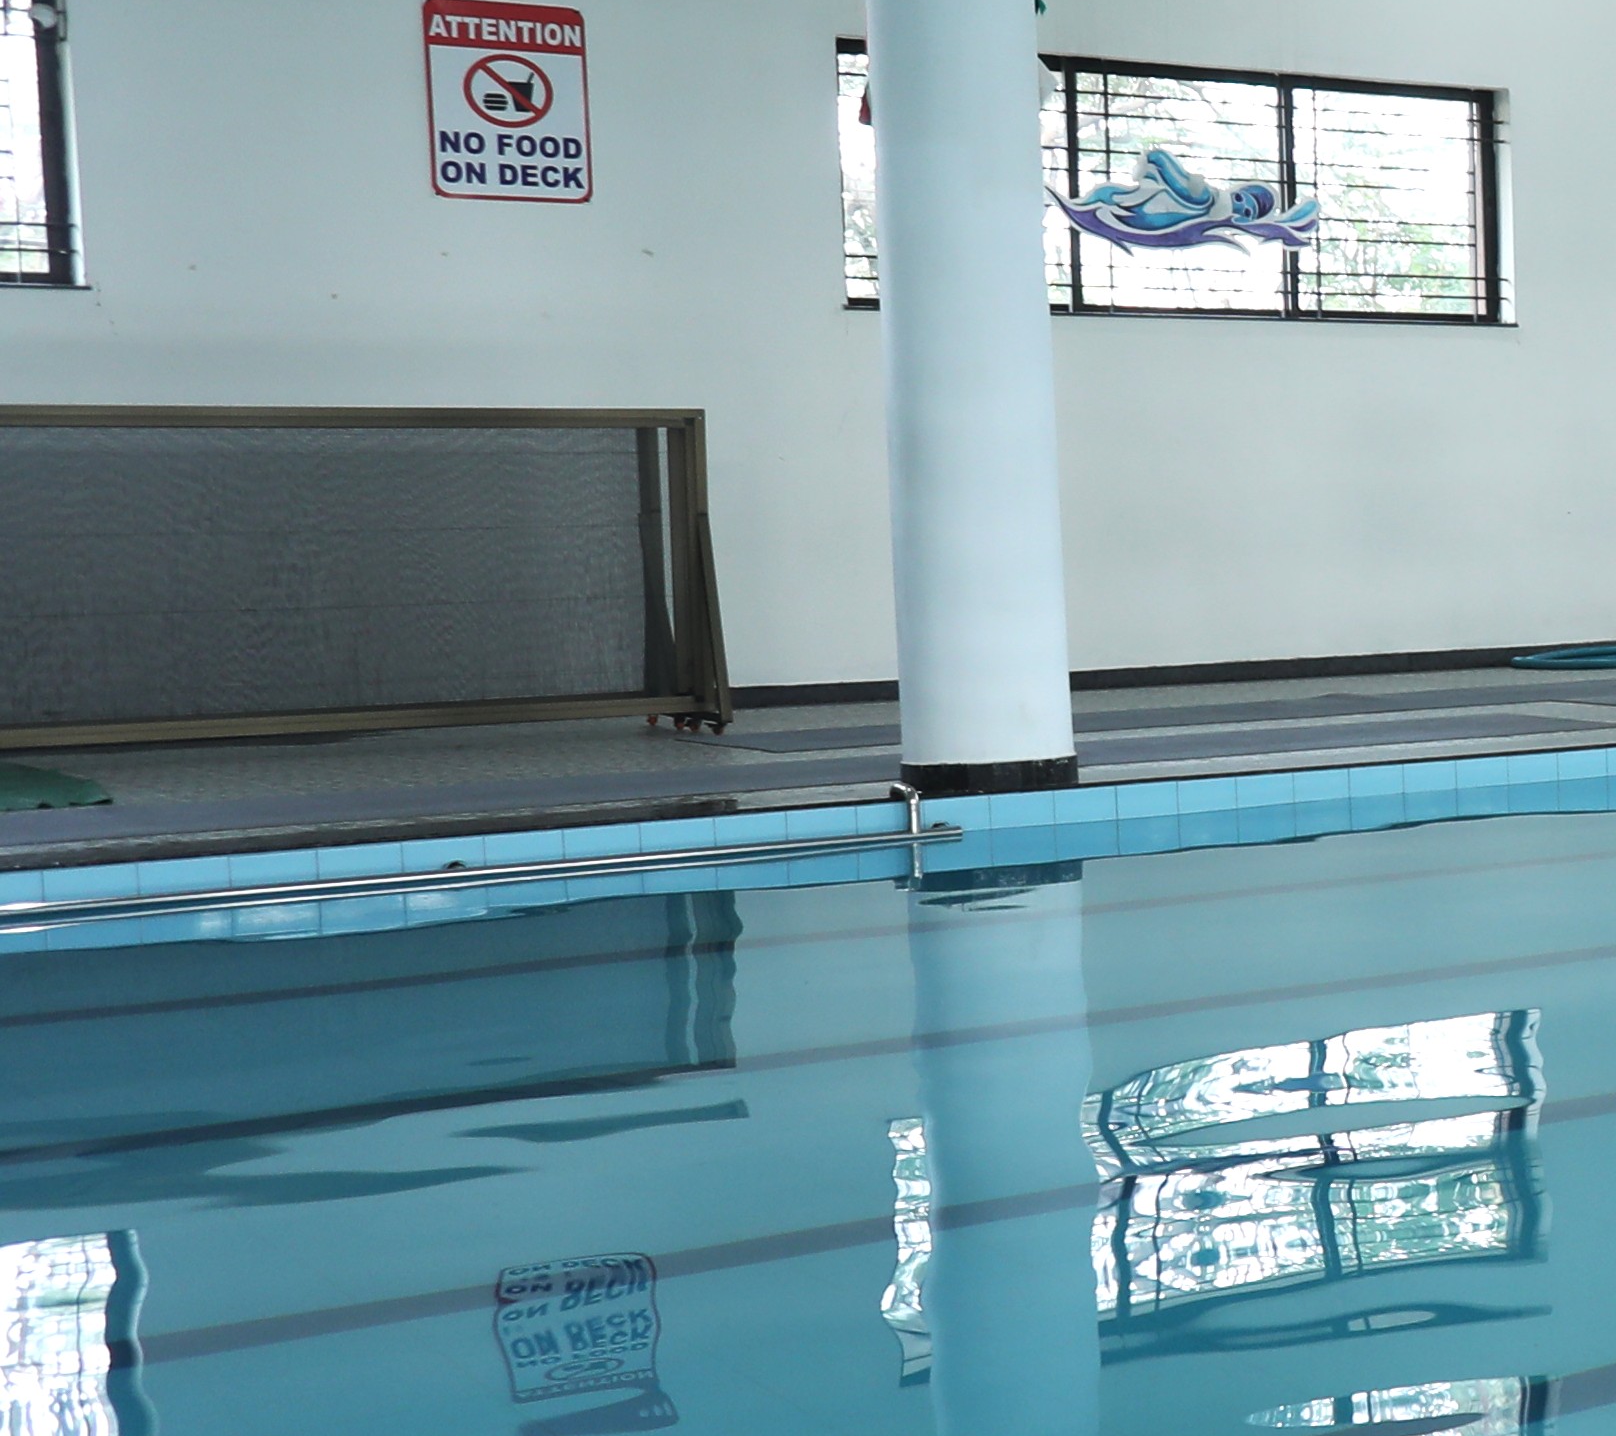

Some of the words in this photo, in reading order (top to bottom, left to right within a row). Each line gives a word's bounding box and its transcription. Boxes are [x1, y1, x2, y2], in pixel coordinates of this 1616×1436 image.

[429, 14, 581, 47] ATTENTION
[439, 131, 485, 154] NO
[497, 134, 583, 159] FOOD
[441, 161, 487, 184] ON
[499, 164, 585, 189] DECK
